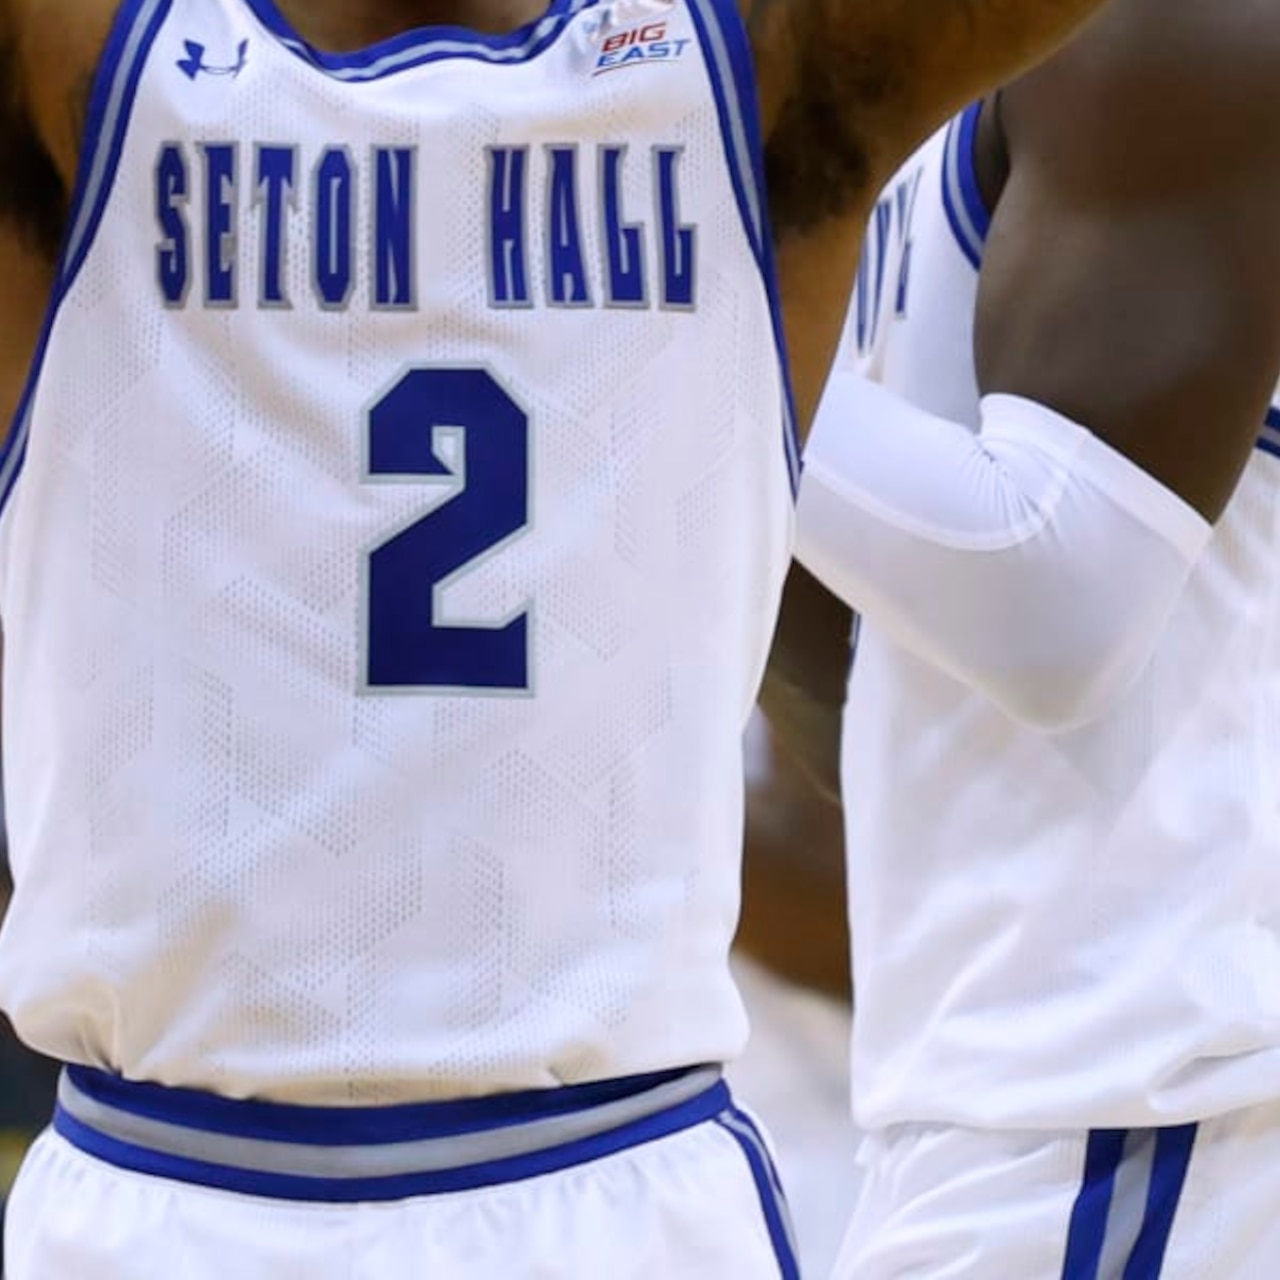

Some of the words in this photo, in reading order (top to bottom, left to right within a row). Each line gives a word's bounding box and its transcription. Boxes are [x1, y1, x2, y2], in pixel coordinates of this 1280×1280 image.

[596, 38, 693, 68] EAST
[601, 21, 667, 53] BIG
[153, 140, 419, 310] SETON
[483, 142, 698, 312] HALL
[356, 359, 537, 699] 2
